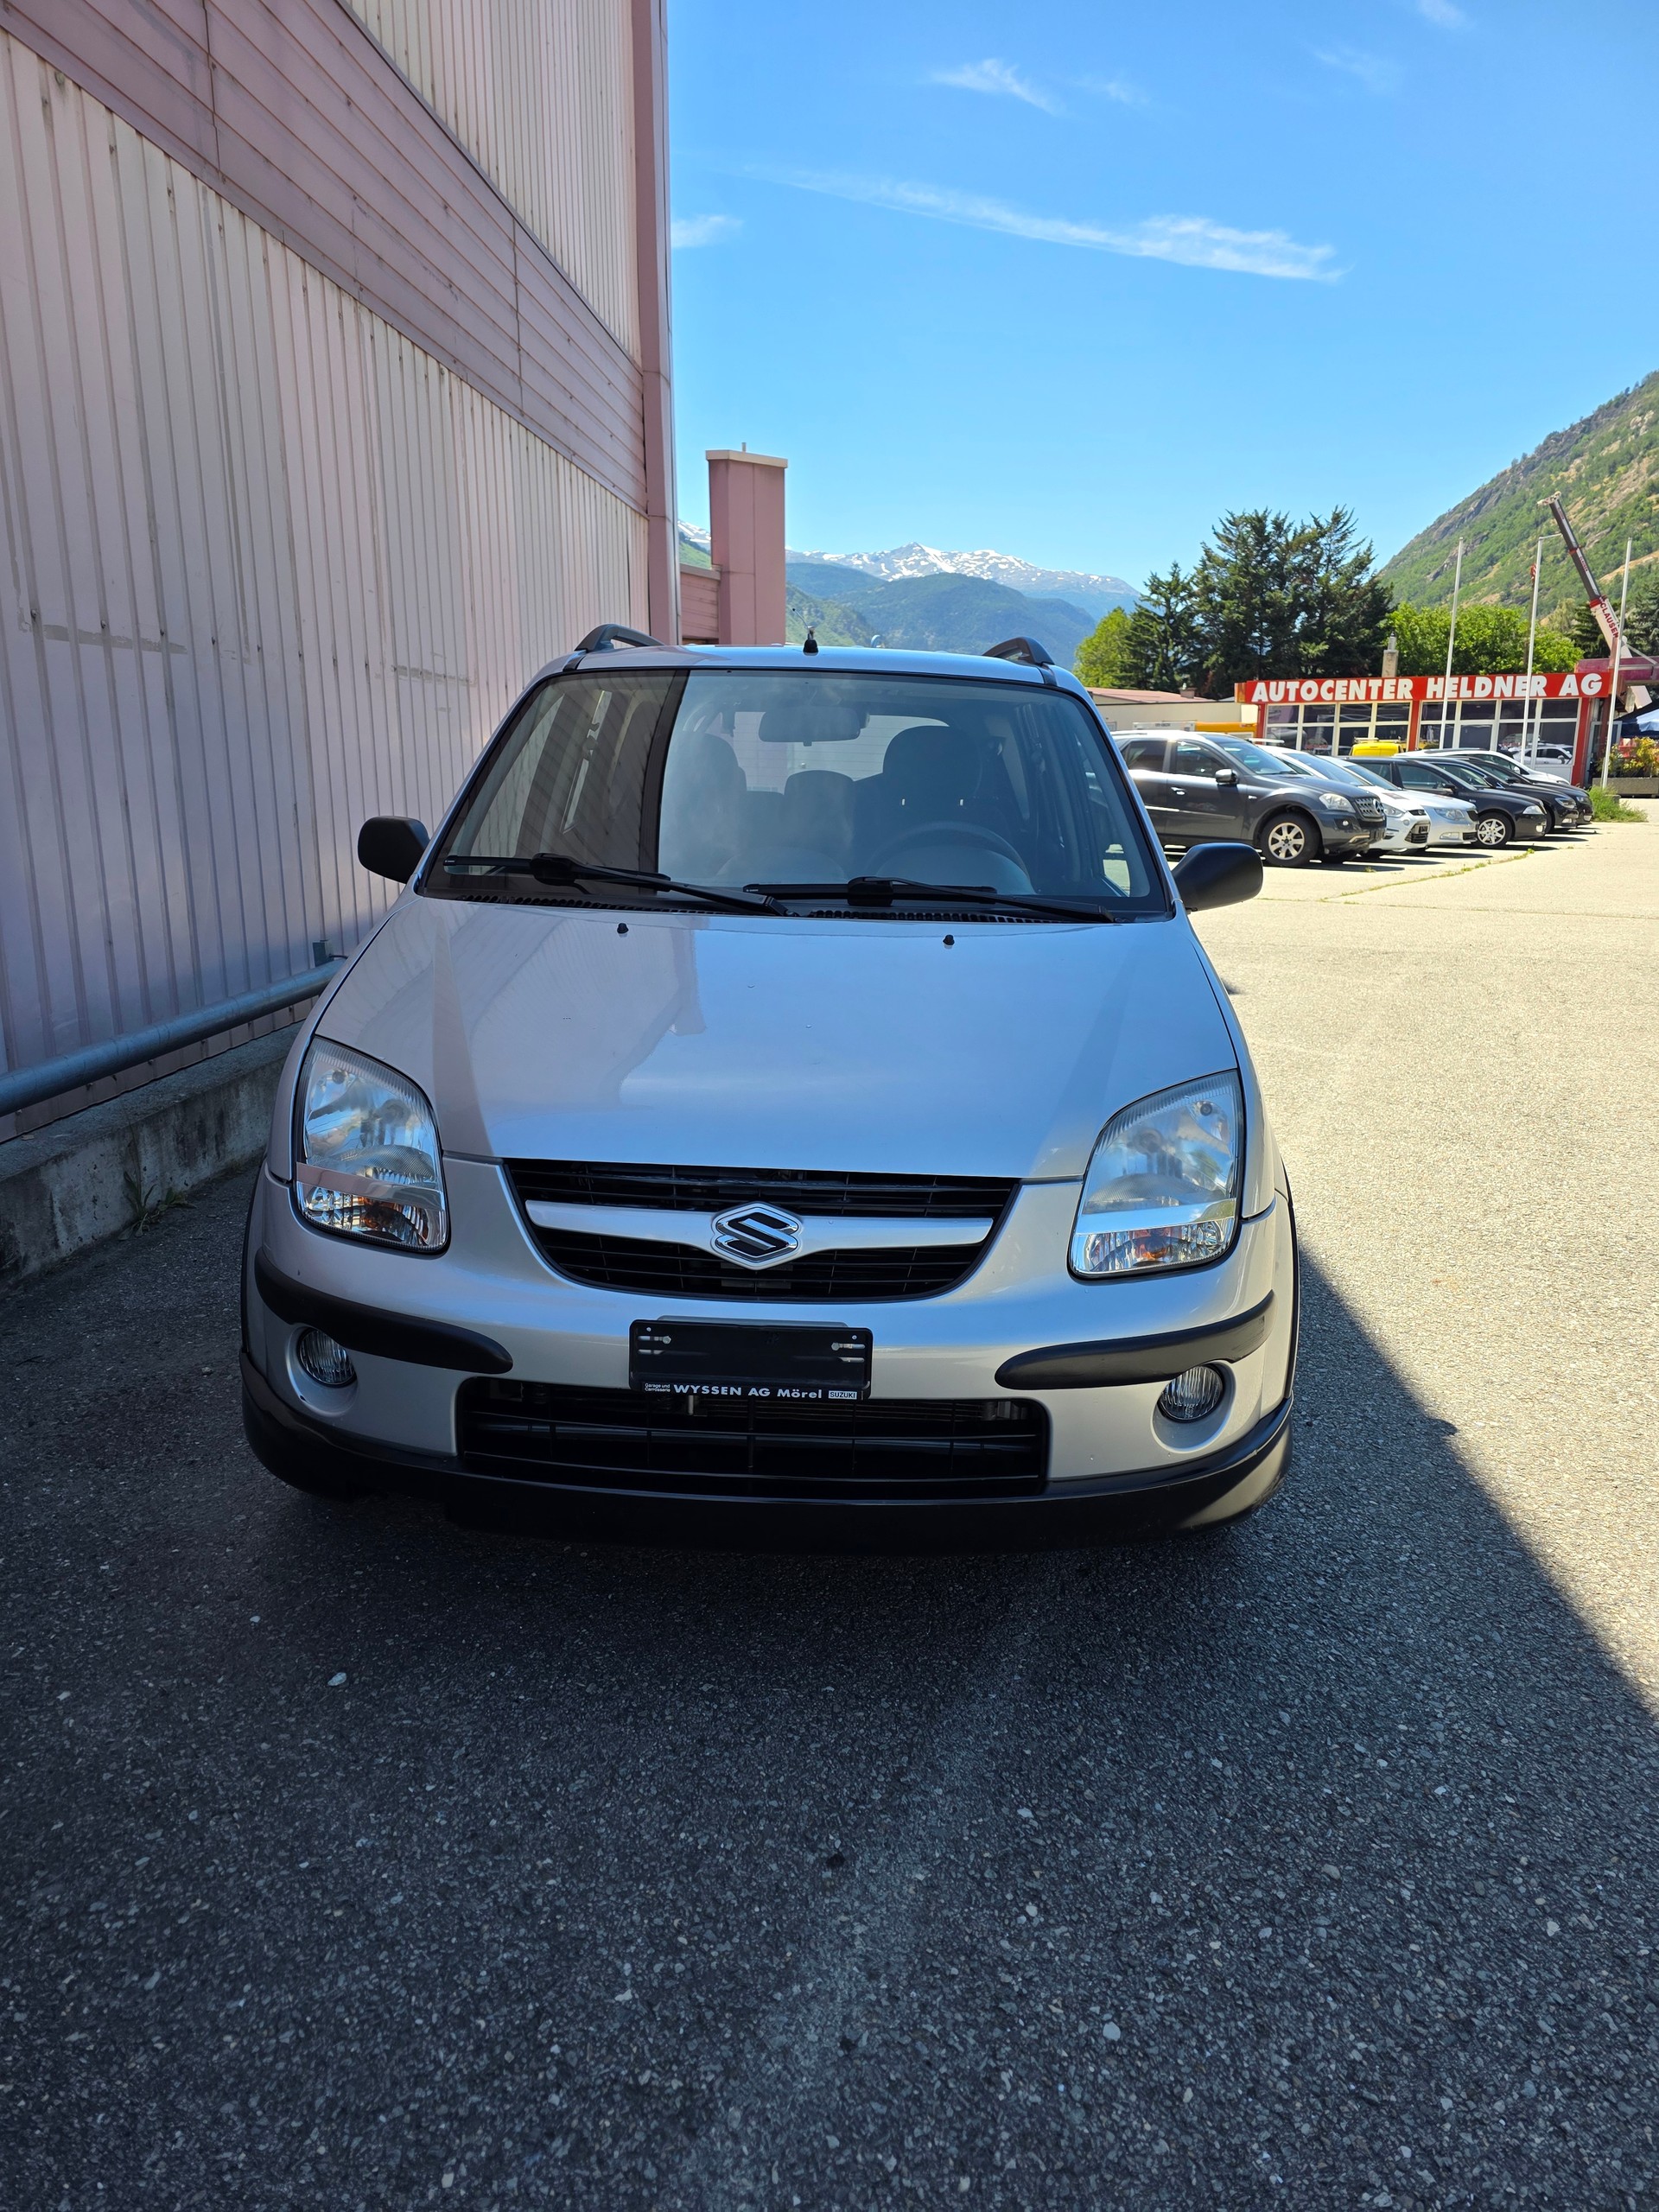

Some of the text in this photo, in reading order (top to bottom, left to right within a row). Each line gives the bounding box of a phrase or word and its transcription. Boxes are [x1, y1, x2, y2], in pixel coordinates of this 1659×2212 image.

[1251, 672, 1602, 702] AUTOCENTER HELDNER AG
[673, 1384, 823, 1399] WYSSEN AG Mörel
